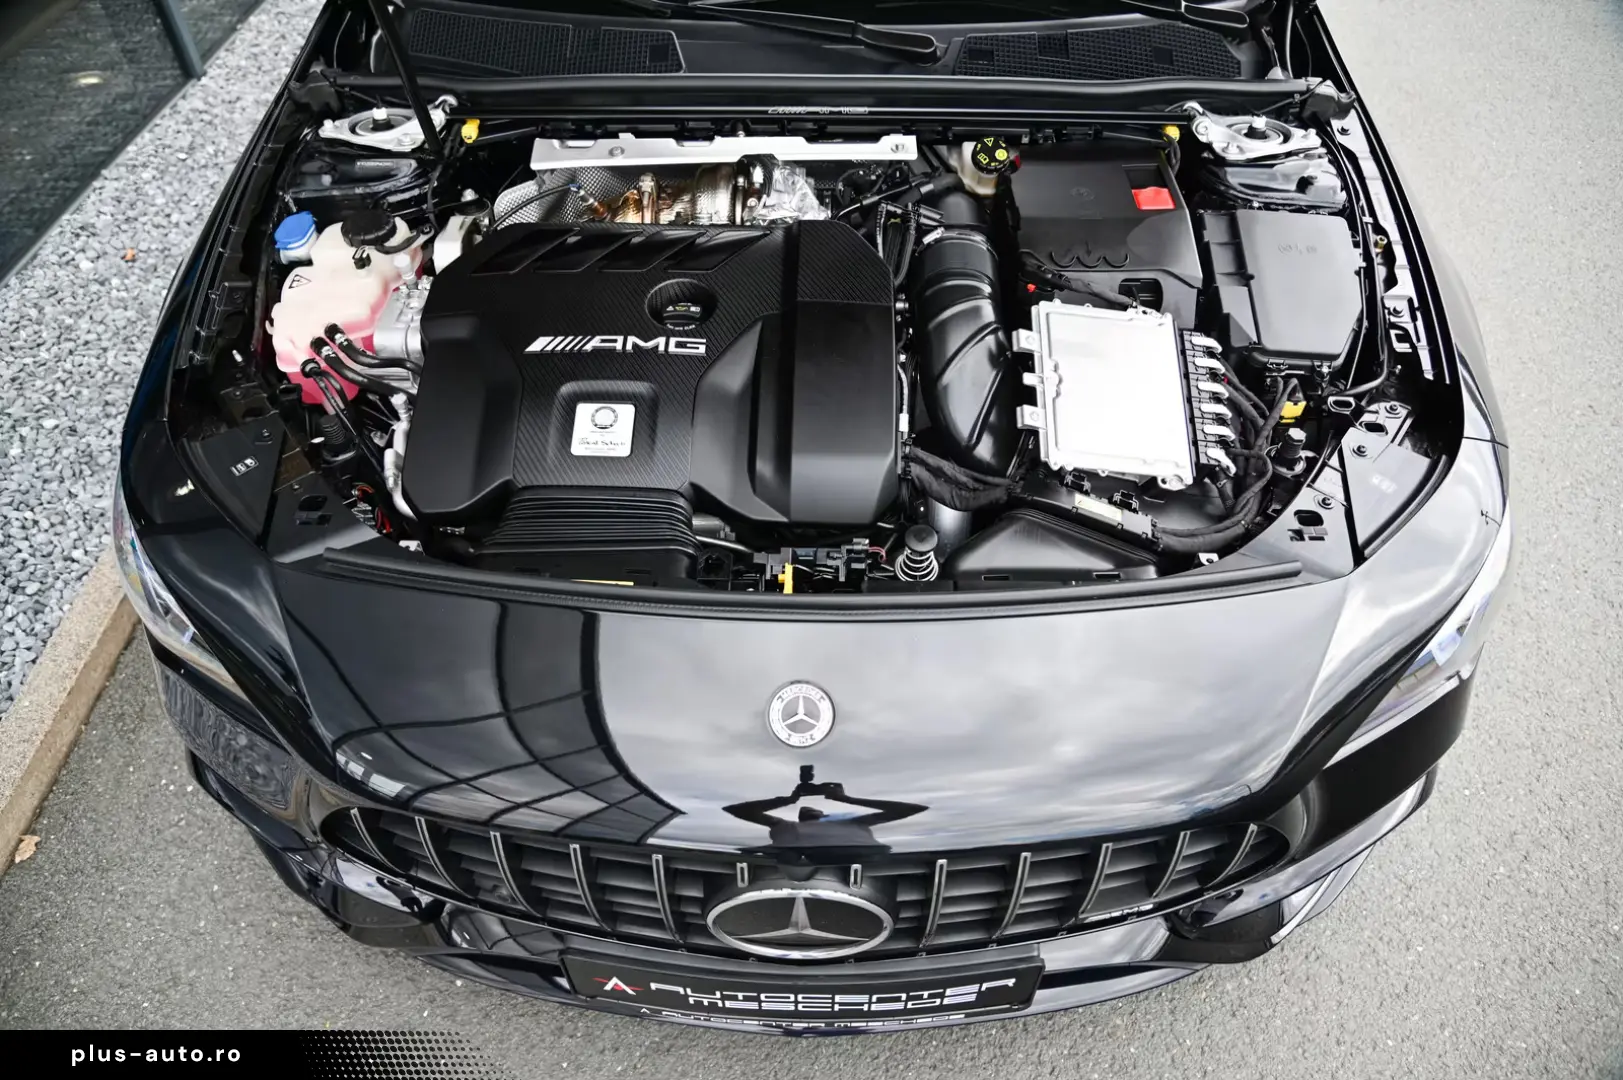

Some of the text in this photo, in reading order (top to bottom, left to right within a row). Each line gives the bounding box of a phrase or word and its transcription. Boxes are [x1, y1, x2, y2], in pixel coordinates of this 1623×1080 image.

[582, 335, 707, 356] AMG
[649, 978, 1016, 1002] AUTOCENTER
[688, 993, 978, 1011] MESCHEDE
